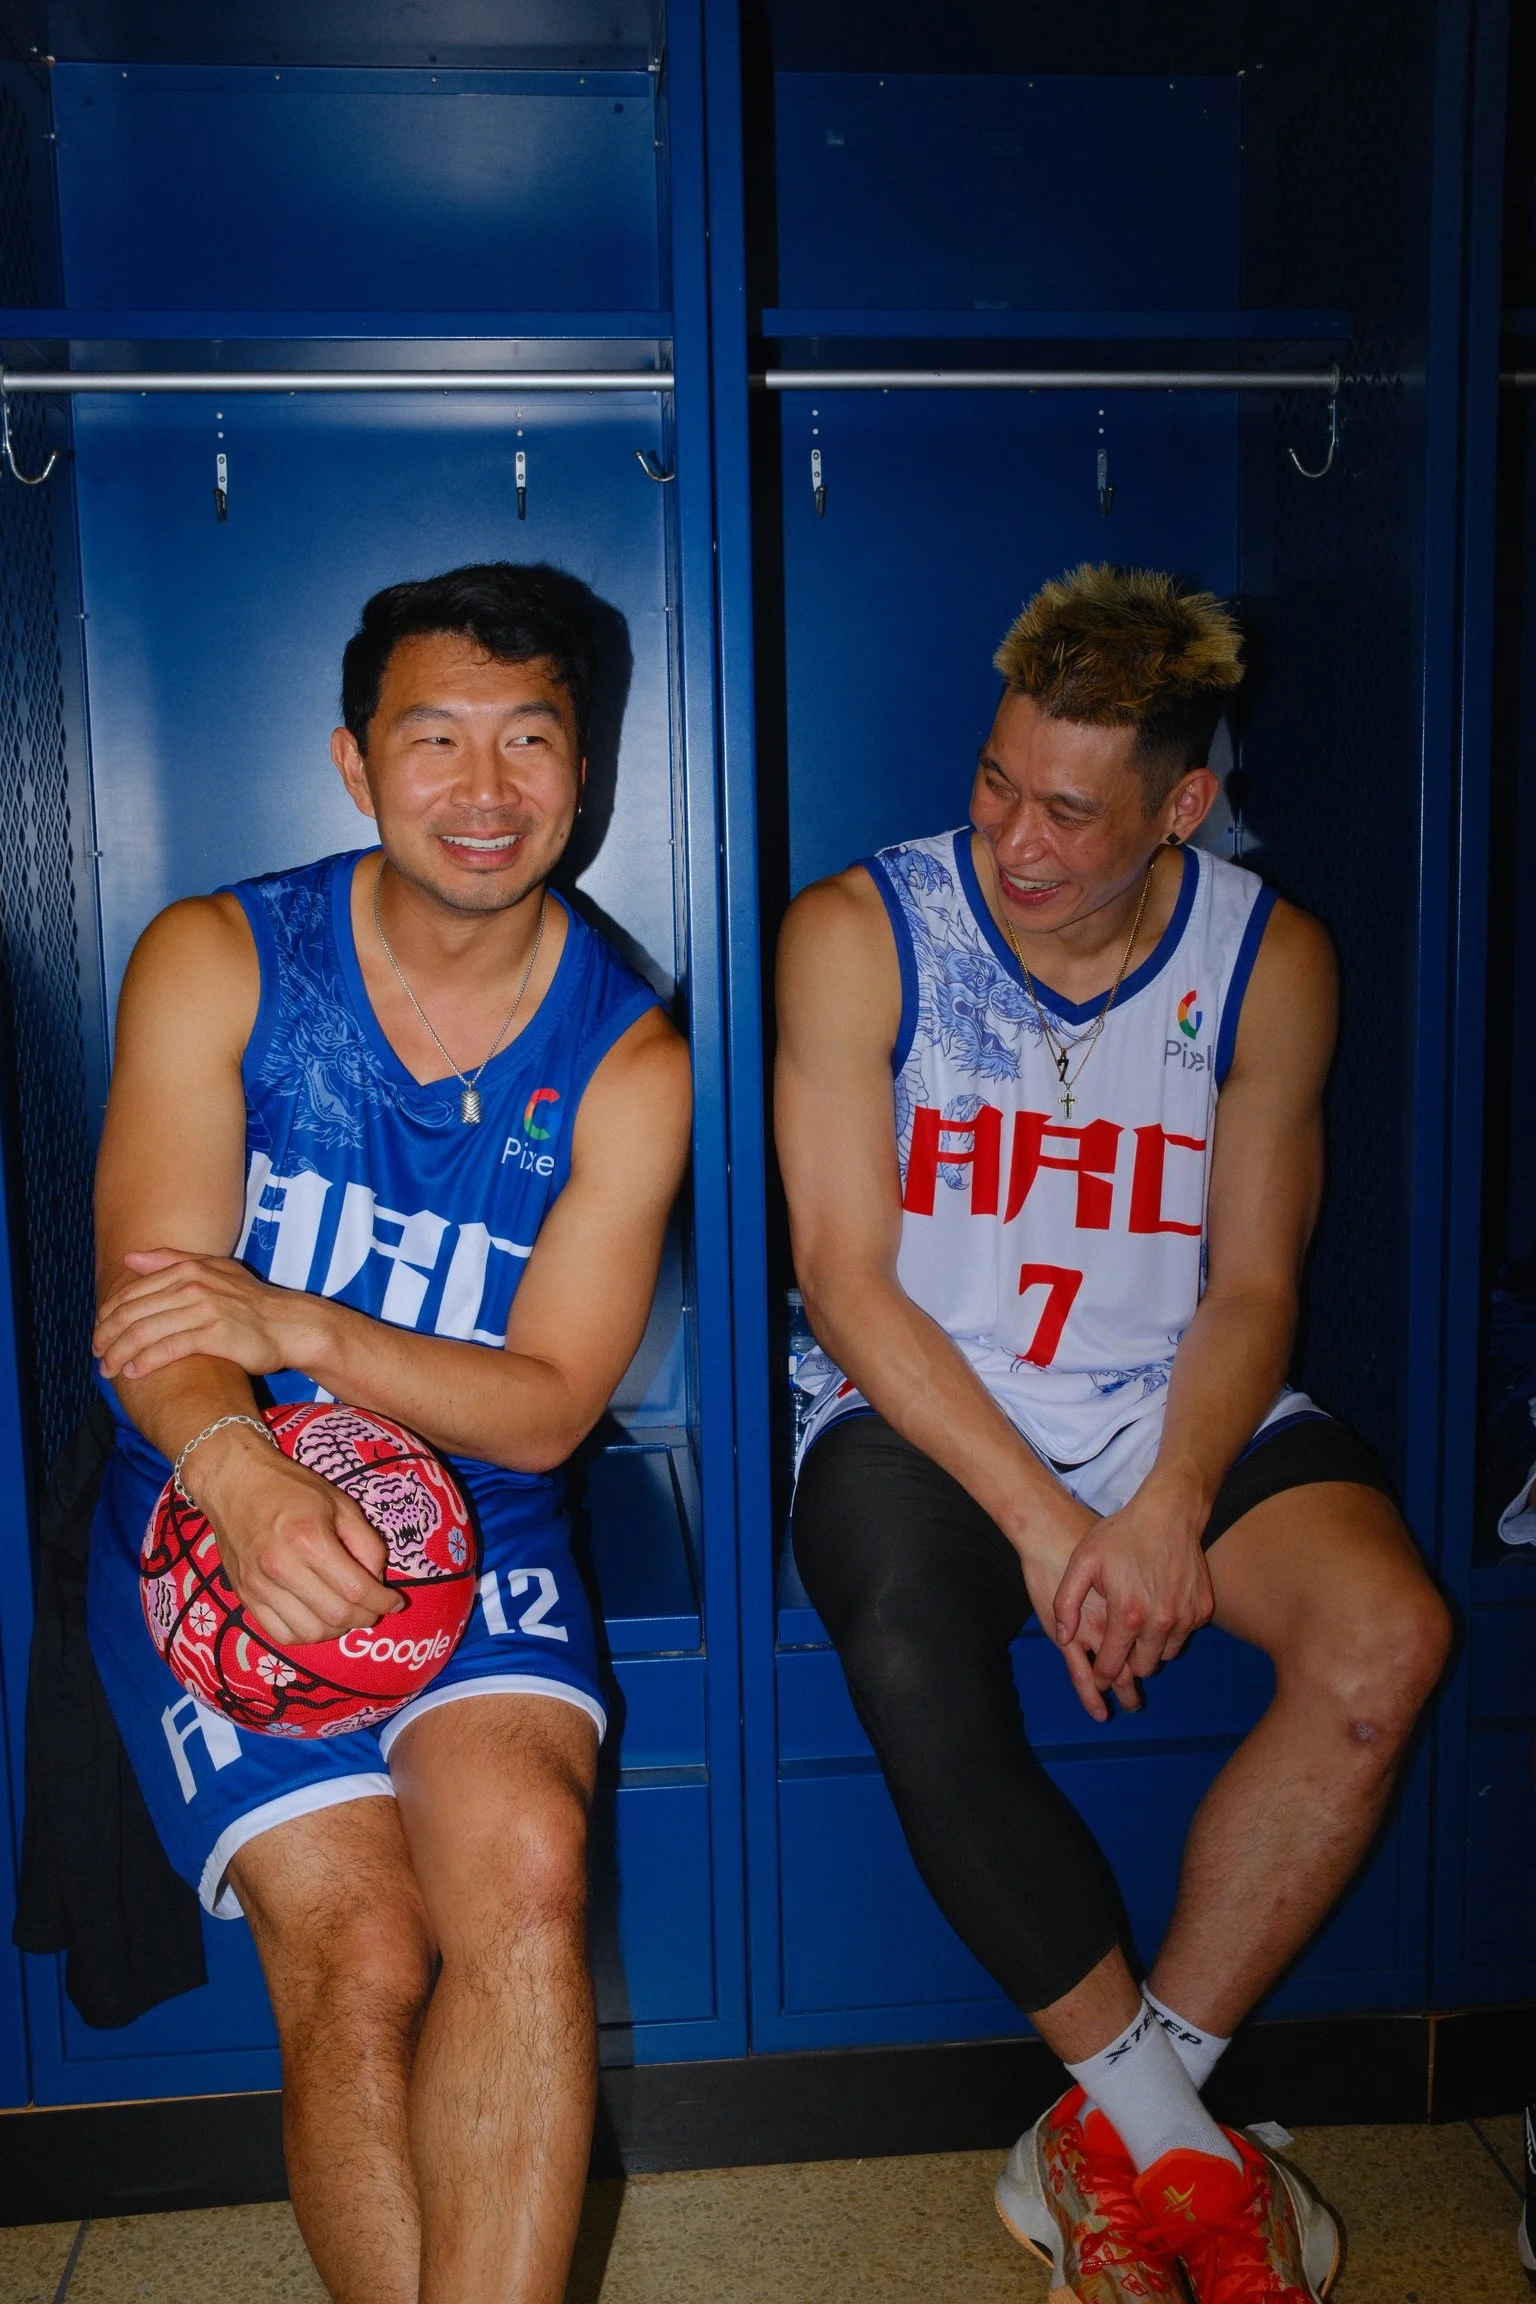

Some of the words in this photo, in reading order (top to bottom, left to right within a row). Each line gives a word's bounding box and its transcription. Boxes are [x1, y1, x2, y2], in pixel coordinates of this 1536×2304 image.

[1164, 1040, 1212, 1072] Pixel
[501, 1137, 555, 1176] Pixe
[1017, 1263, 1084, 1368] 7
[475, 1567, 569, 1643] 12
[338, 1627, 451, 1671] Google
